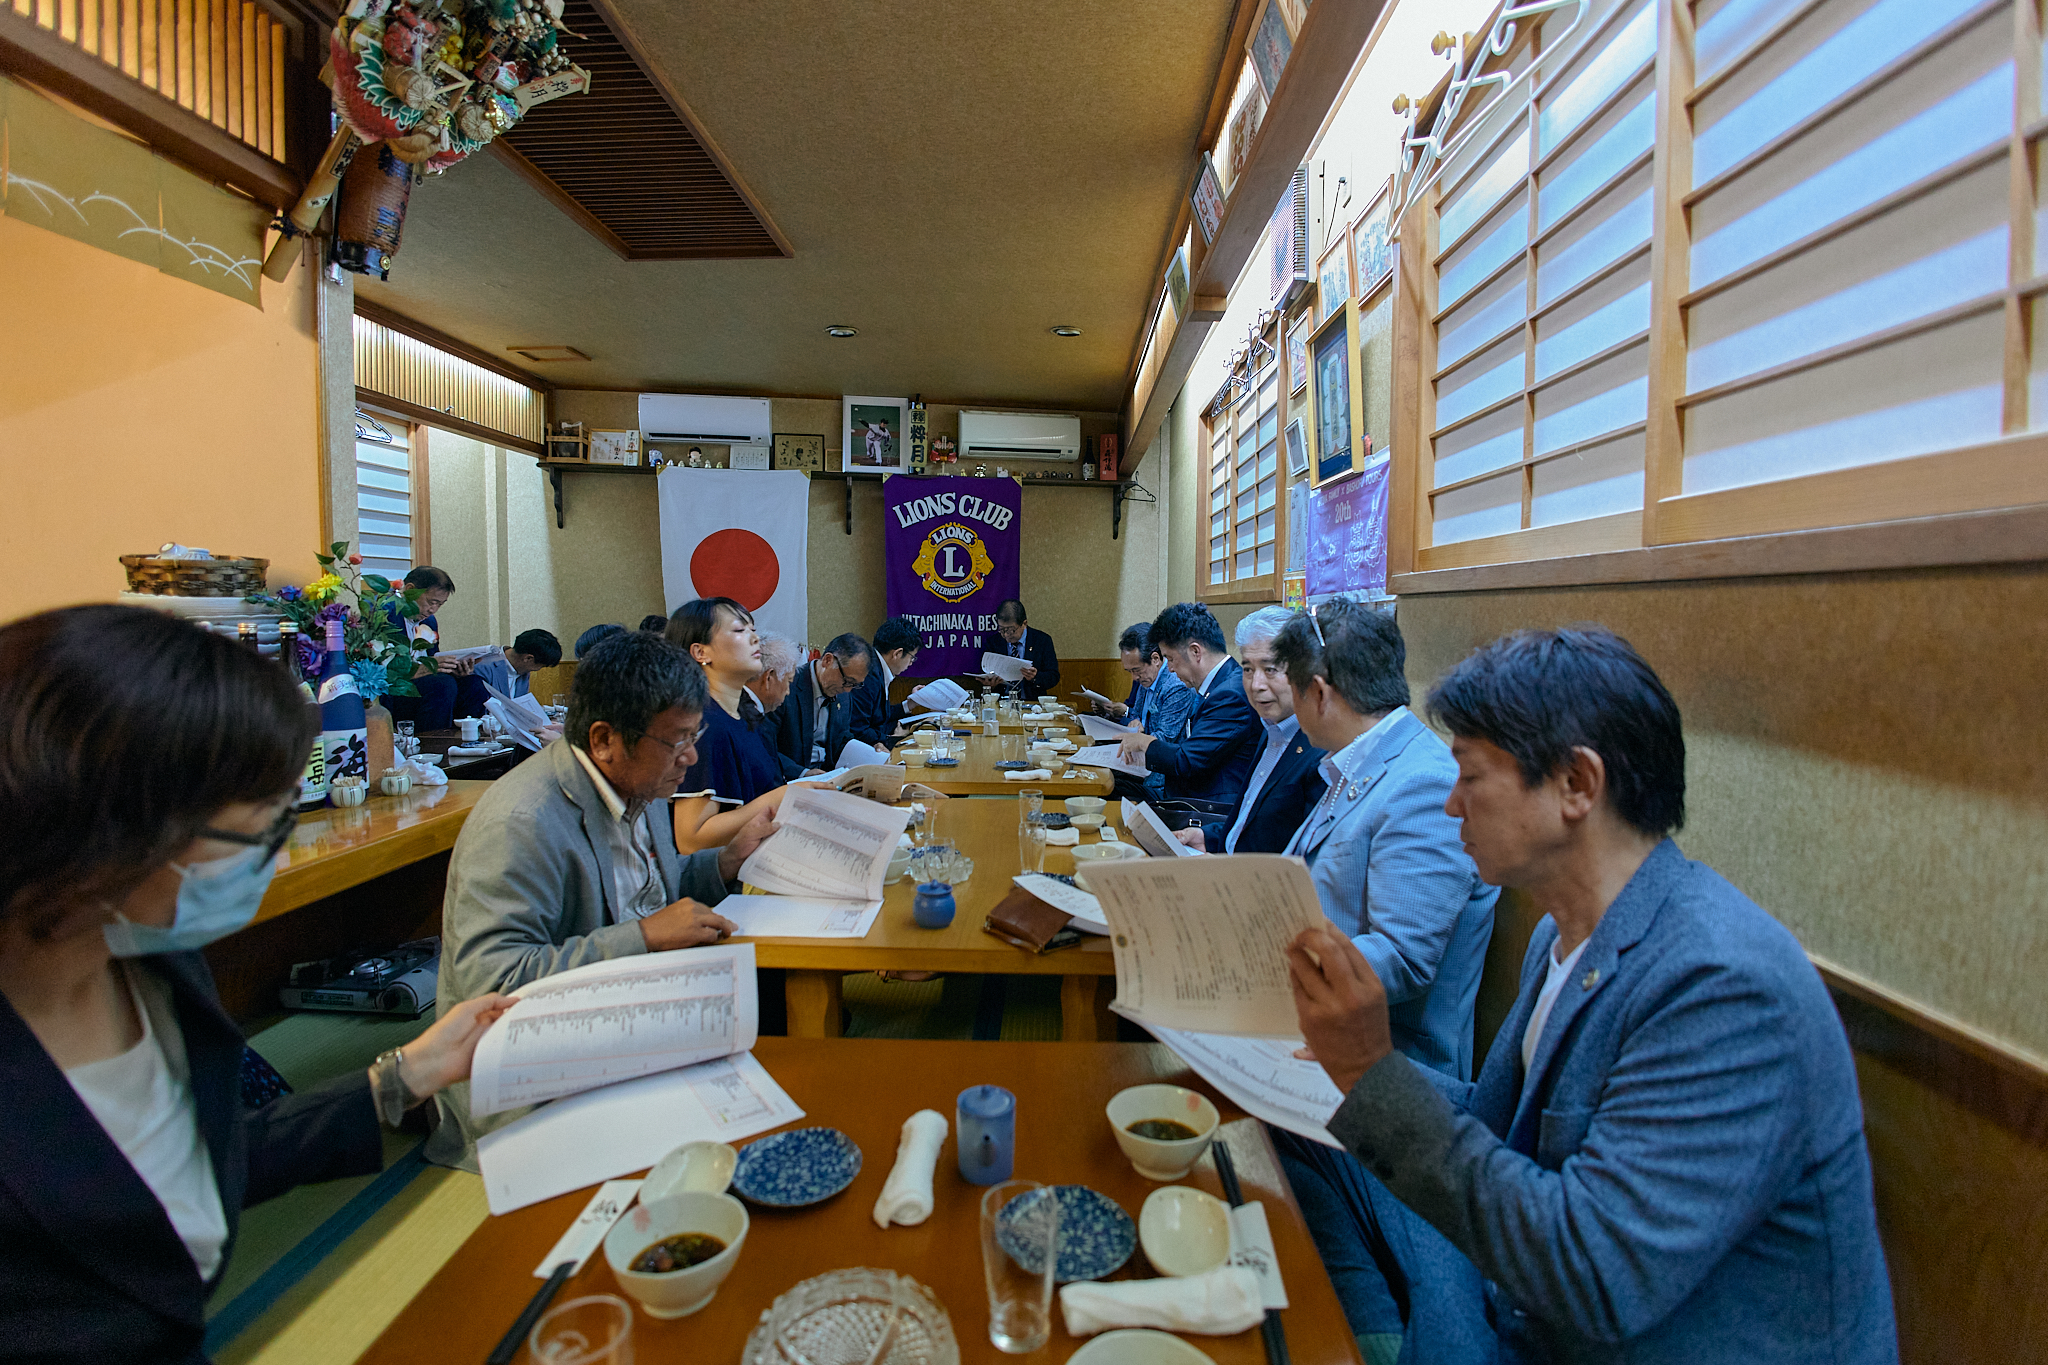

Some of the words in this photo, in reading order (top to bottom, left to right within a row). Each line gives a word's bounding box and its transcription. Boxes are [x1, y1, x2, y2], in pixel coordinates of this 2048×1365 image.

[892, 492, 956, 529] LIONS
[958, 494, 1014, 531] CLUB
[1335, 500, 1352, 523] 20th
[931, 526, 975, 544] LIONS
[943, 546, 966, 578] L
[930, 580, 977, 596] INTERNATIONAL
[902, 613, 973, 632] TACHINAKA
[978, 613, 998, 632] BES
[925, 634, 982, 649] JAPAN
